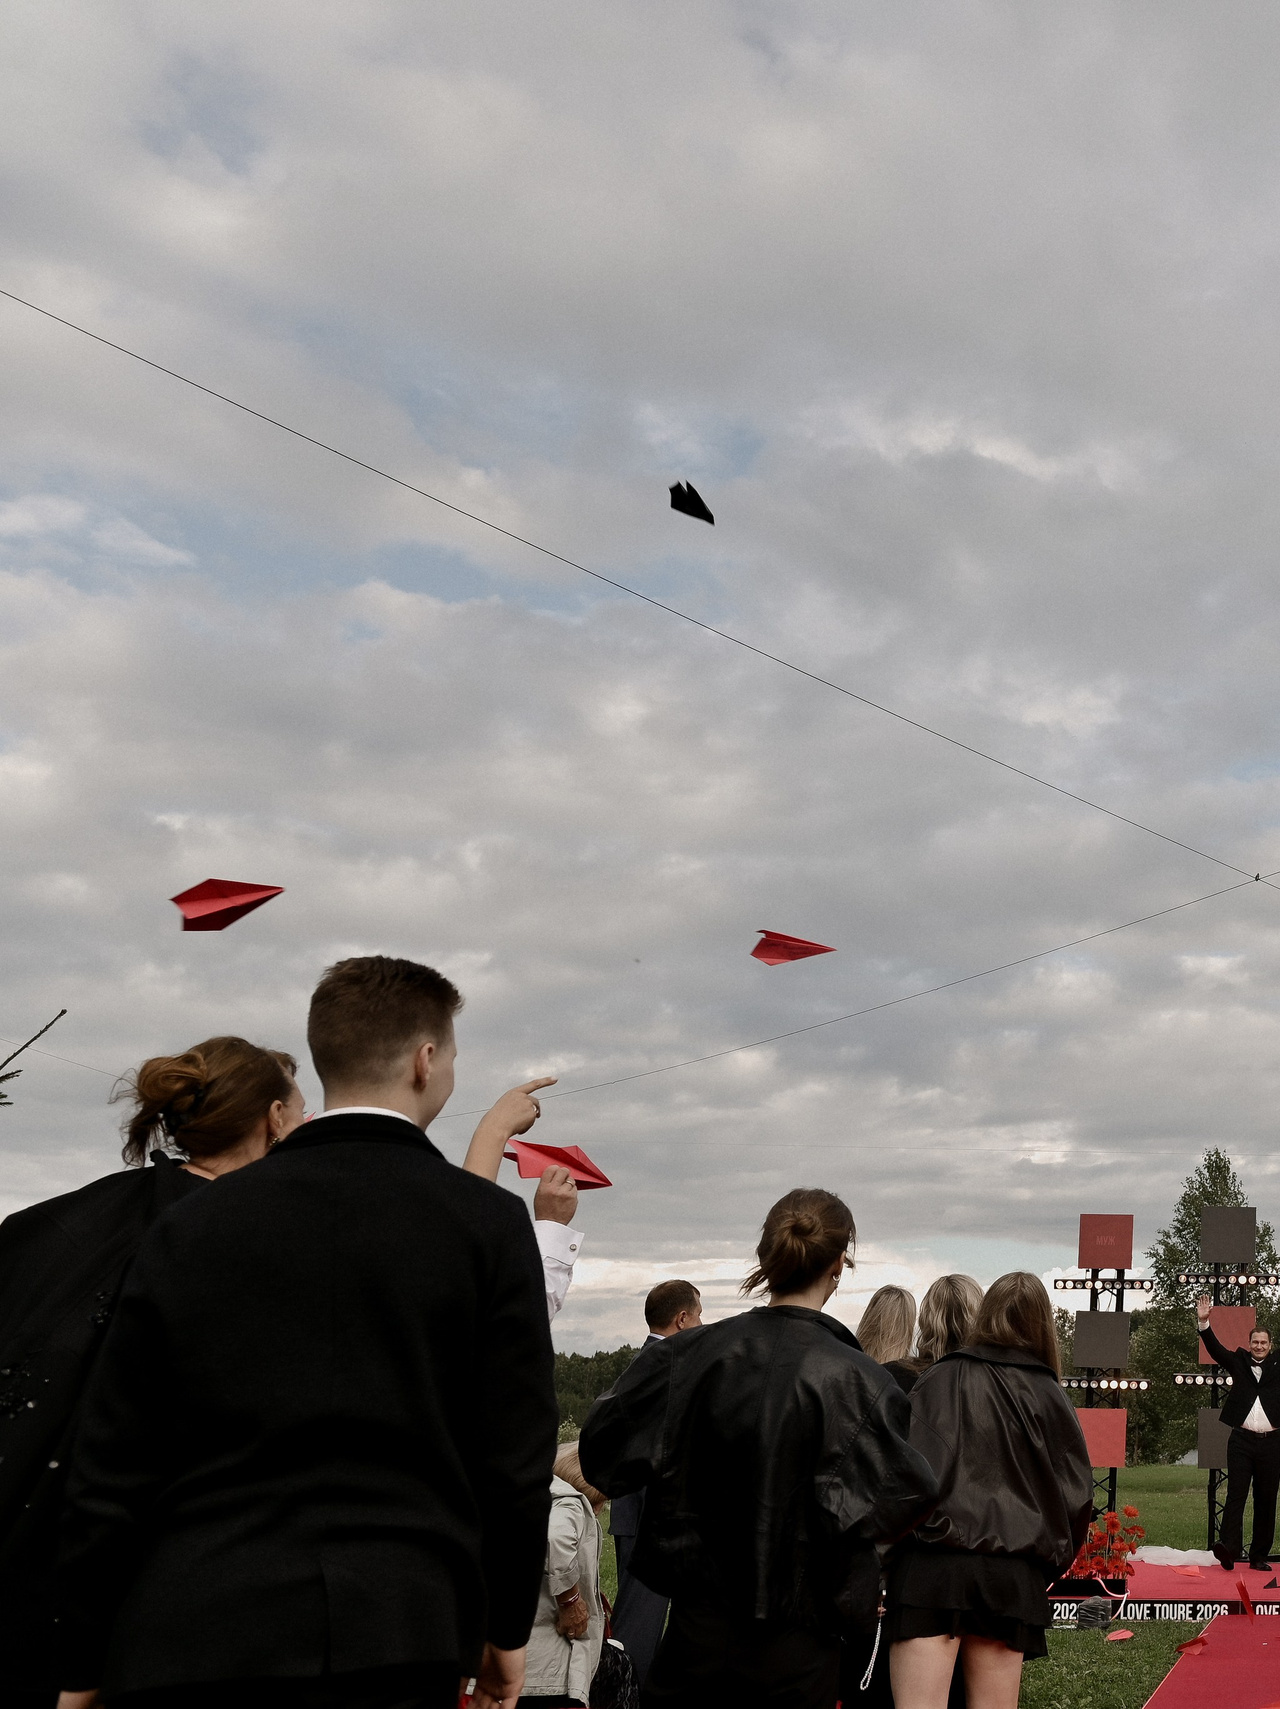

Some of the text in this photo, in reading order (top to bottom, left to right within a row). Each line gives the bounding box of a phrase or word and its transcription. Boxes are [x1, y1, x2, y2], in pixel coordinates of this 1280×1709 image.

[1096, 1235, 1116, 1246] МУЖ
[1053, 1602, 1079, 1620] 202
[1120, 1603, 1228, 1621] LOVE TOURE 2026
[1250, 1604, 1279, 1615] OVE
